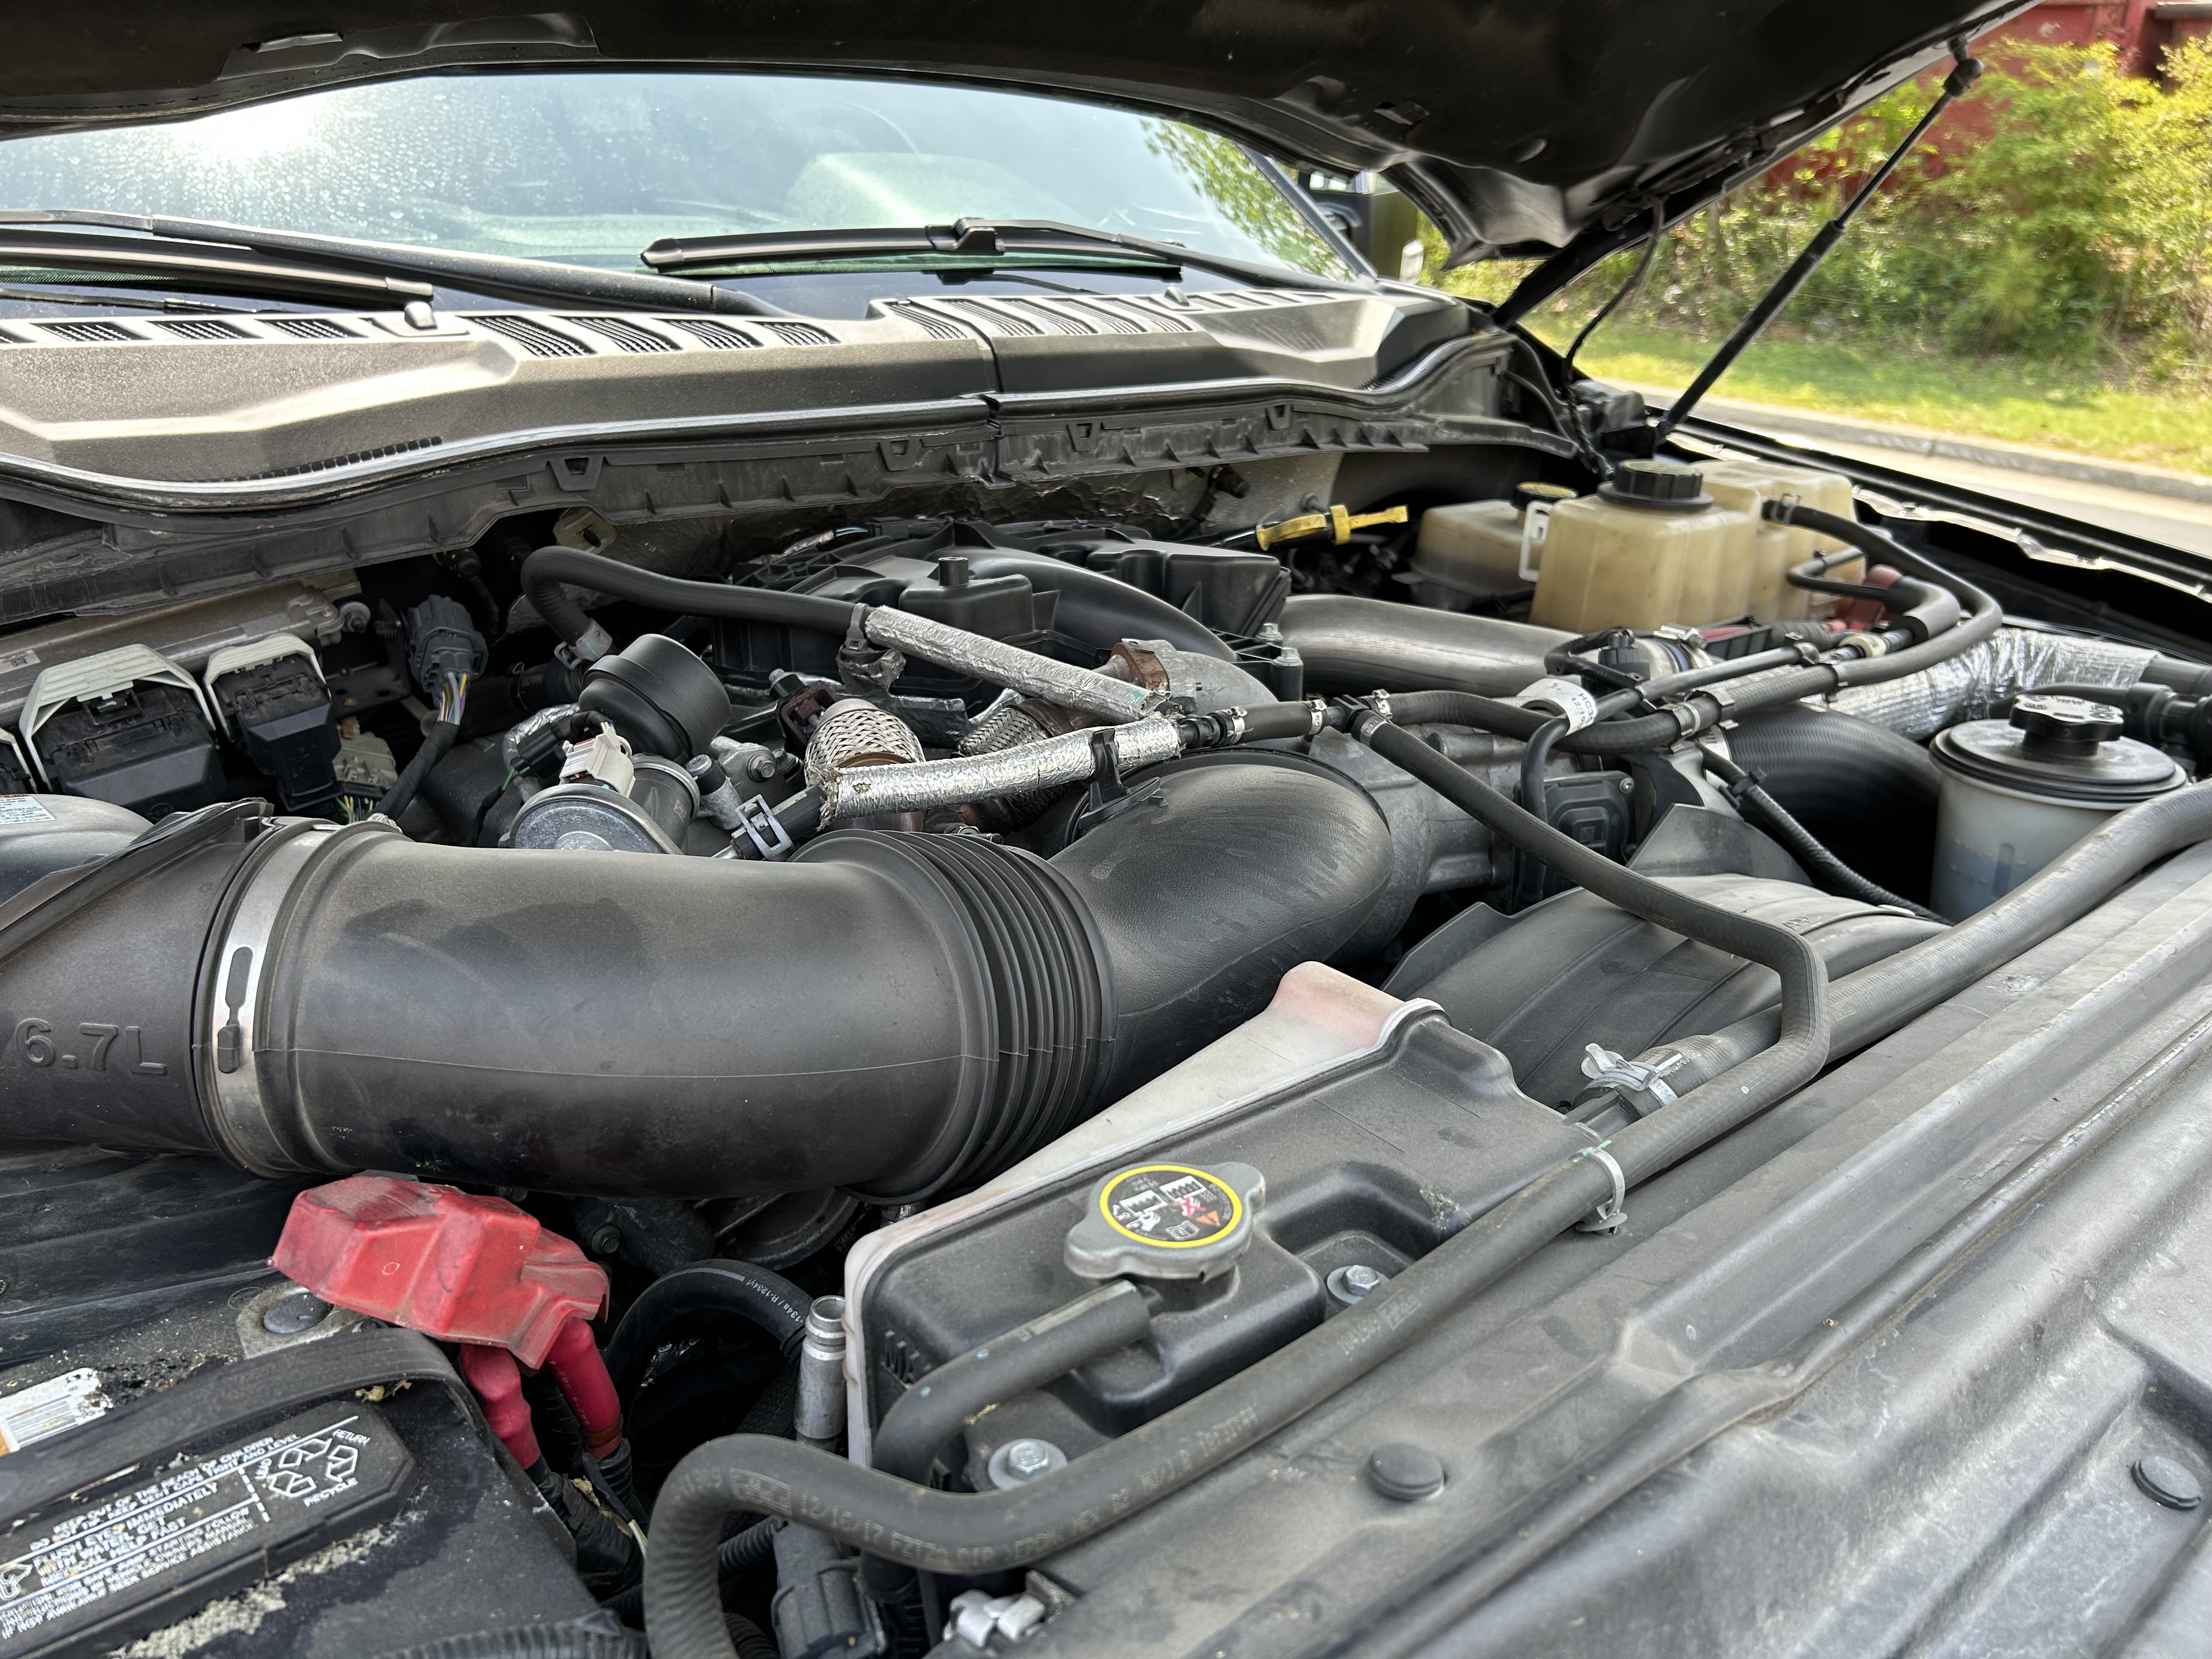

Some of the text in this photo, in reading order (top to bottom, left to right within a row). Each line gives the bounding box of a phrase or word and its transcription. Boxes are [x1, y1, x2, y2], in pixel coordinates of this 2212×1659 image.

[15, 1018, 167, 1075] 6.7L
[747, 1279, 780, 1304] R-1234yf
[783, 1302, 804, 1323] -134a
[332, 1428, 371, 1446] RETURN
[86, 1502, 113, 1520] OUT
[114, 1494, 133, 1508] OF
[134, 1483, 159, 1500] THE
[159, 1466, 200, 1489] REACH
[200, 1458, 218, 1472] OF
[218, 1434, 274, 1464] CHILDREN
[139, 1487, 170, 1506] VENT
[171, 1472, 204, 1492] CAPS
[206, 1457, 239, 1477] TIGHT
[240, 1446, 266, 1463] AND
[267, 1431, 301, 1451] LEVEL
[256, 1458, 272, 1481] LEAD
[304, 1479, 358, 1506] RECYCLE
[32, 1538, 83, 1569] FLUSH
[125, 1480, 220, 1530] IMMEDIATELY
[135, 1514, 167, 1536] GET
[204, 1506, 250, 1532] FOLLOW
[39, 1515, 188, 1588] MEDICAL HELP FAST
